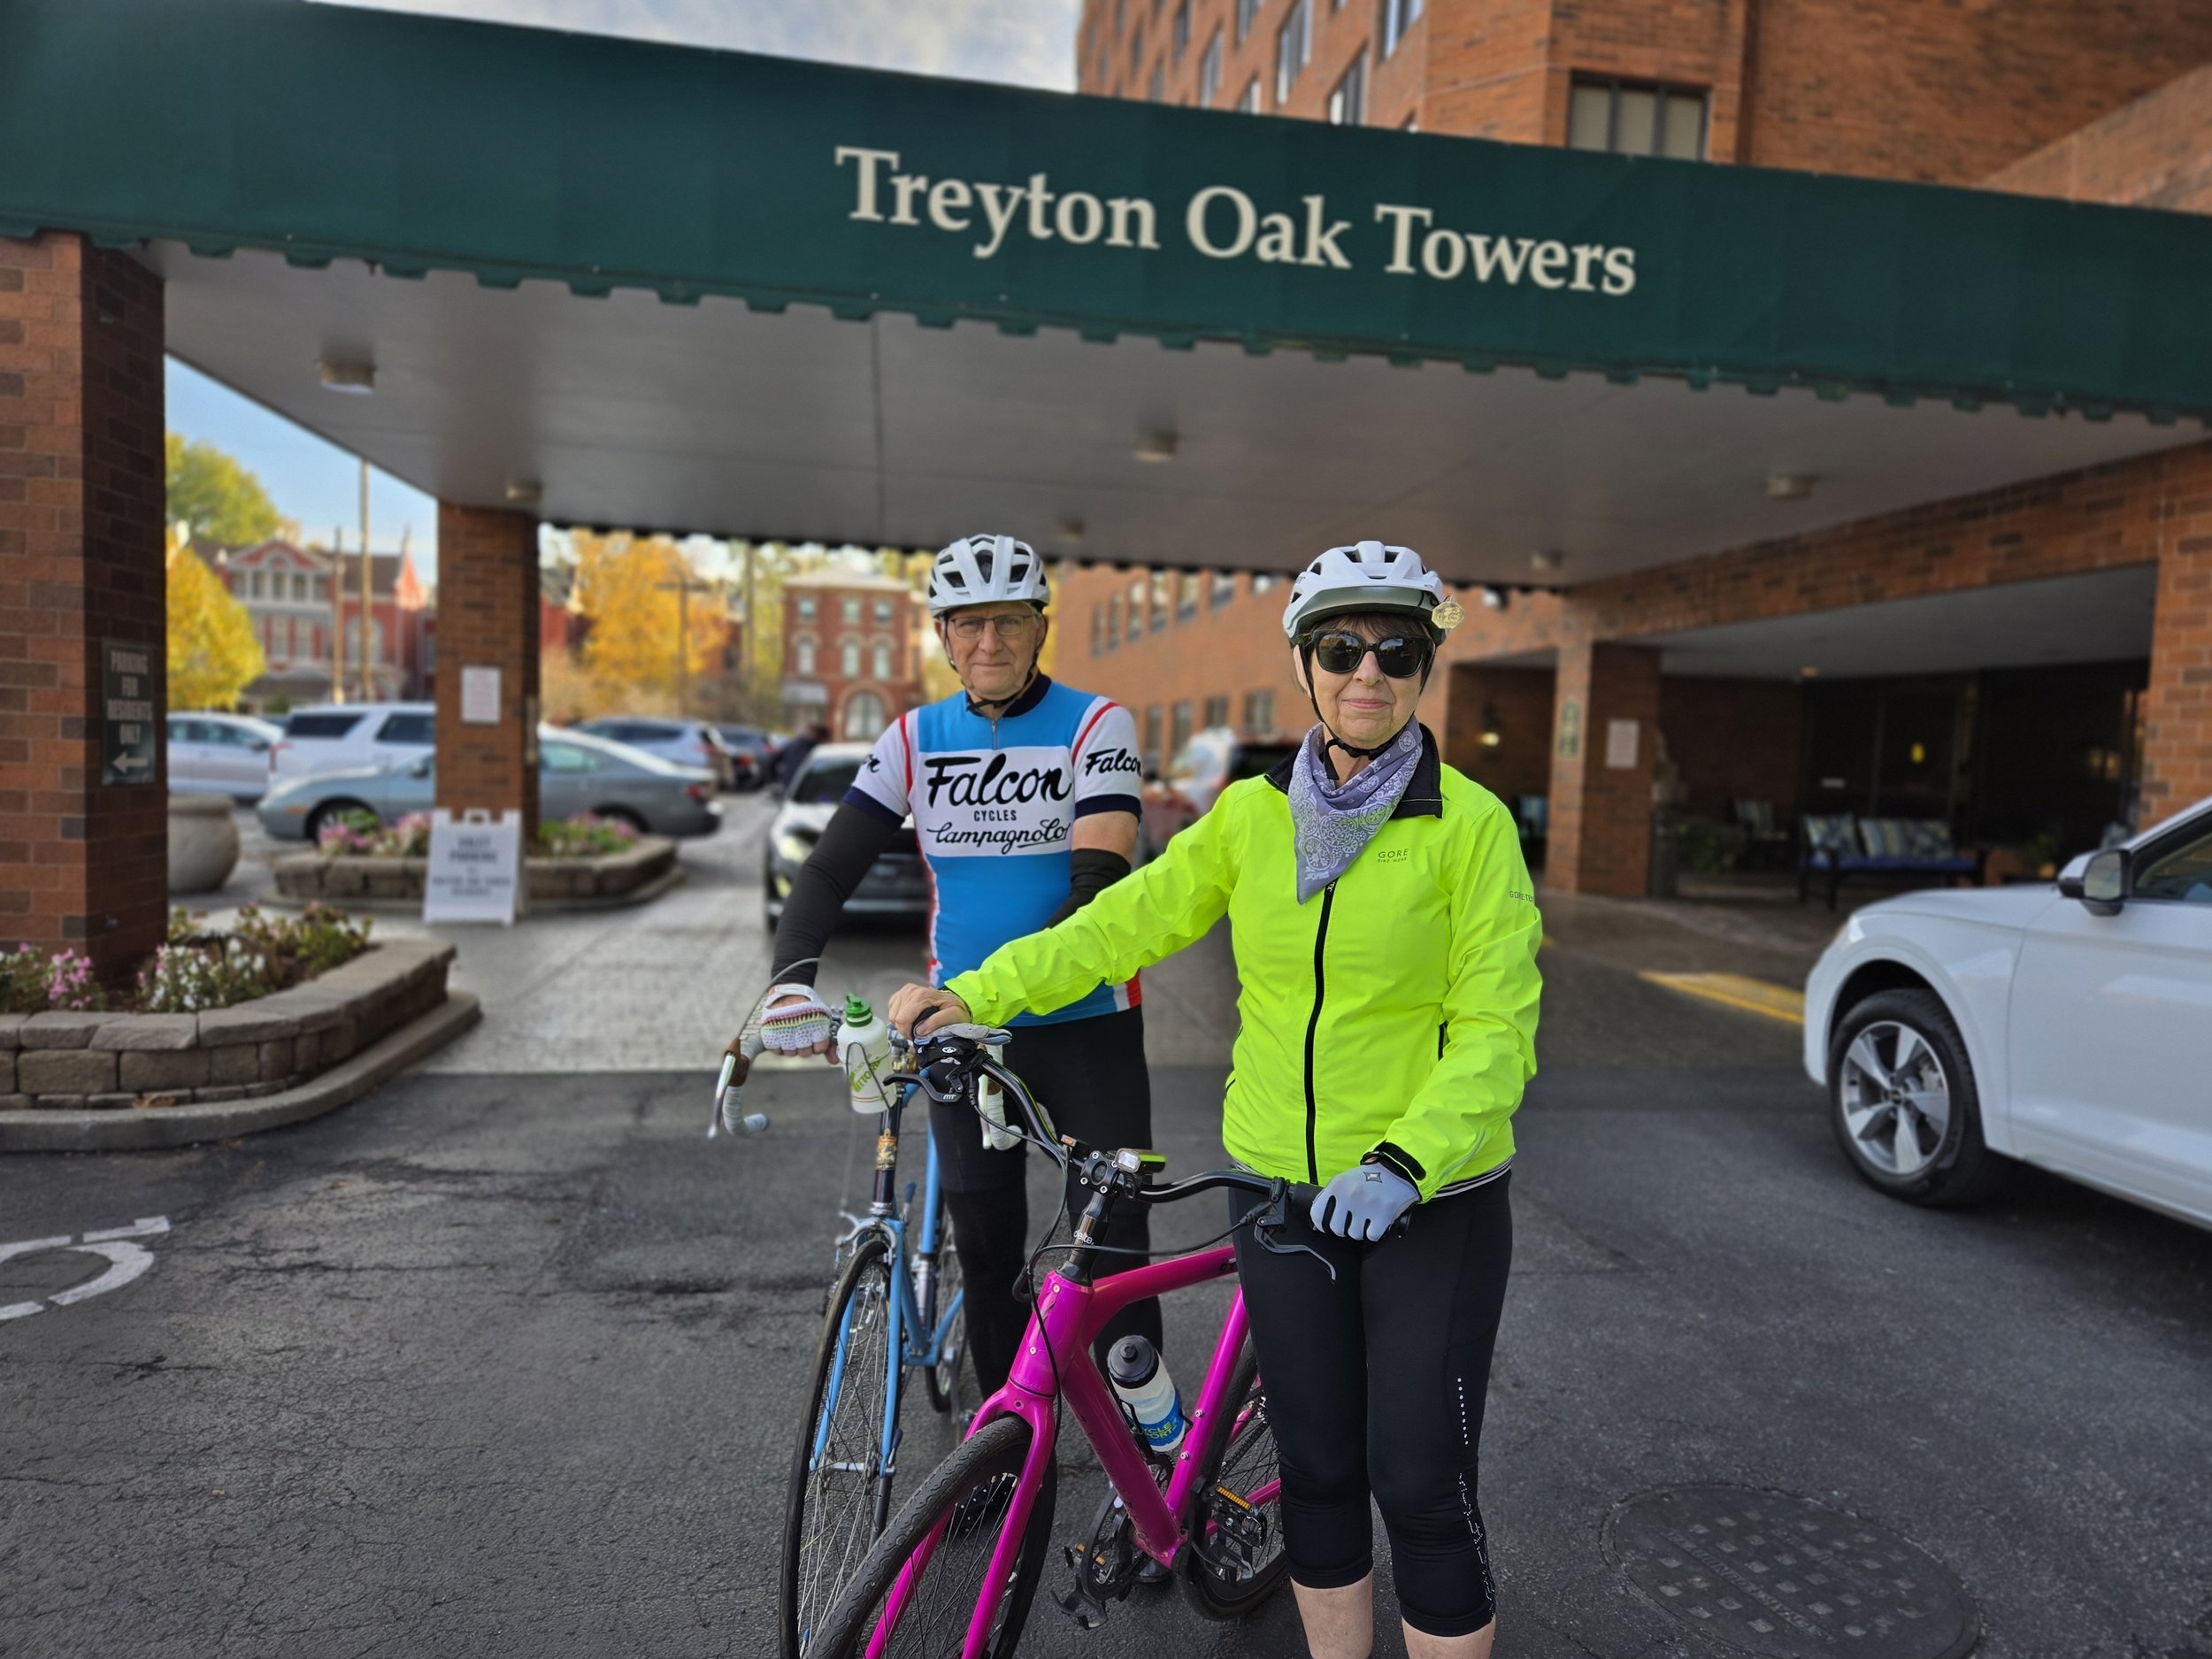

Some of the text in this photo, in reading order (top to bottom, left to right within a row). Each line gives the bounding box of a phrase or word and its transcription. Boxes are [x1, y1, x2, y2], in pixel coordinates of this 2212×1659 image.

[835, 146, 1636, 296] Treyton Oak Towers
[924, 752, 1073, 810] Falcon
[972, 809, 1018, 822] CYCLES
[926, 817, 1071, 856] Campagnolo
[1378, 848, 1409, 858] GORE
